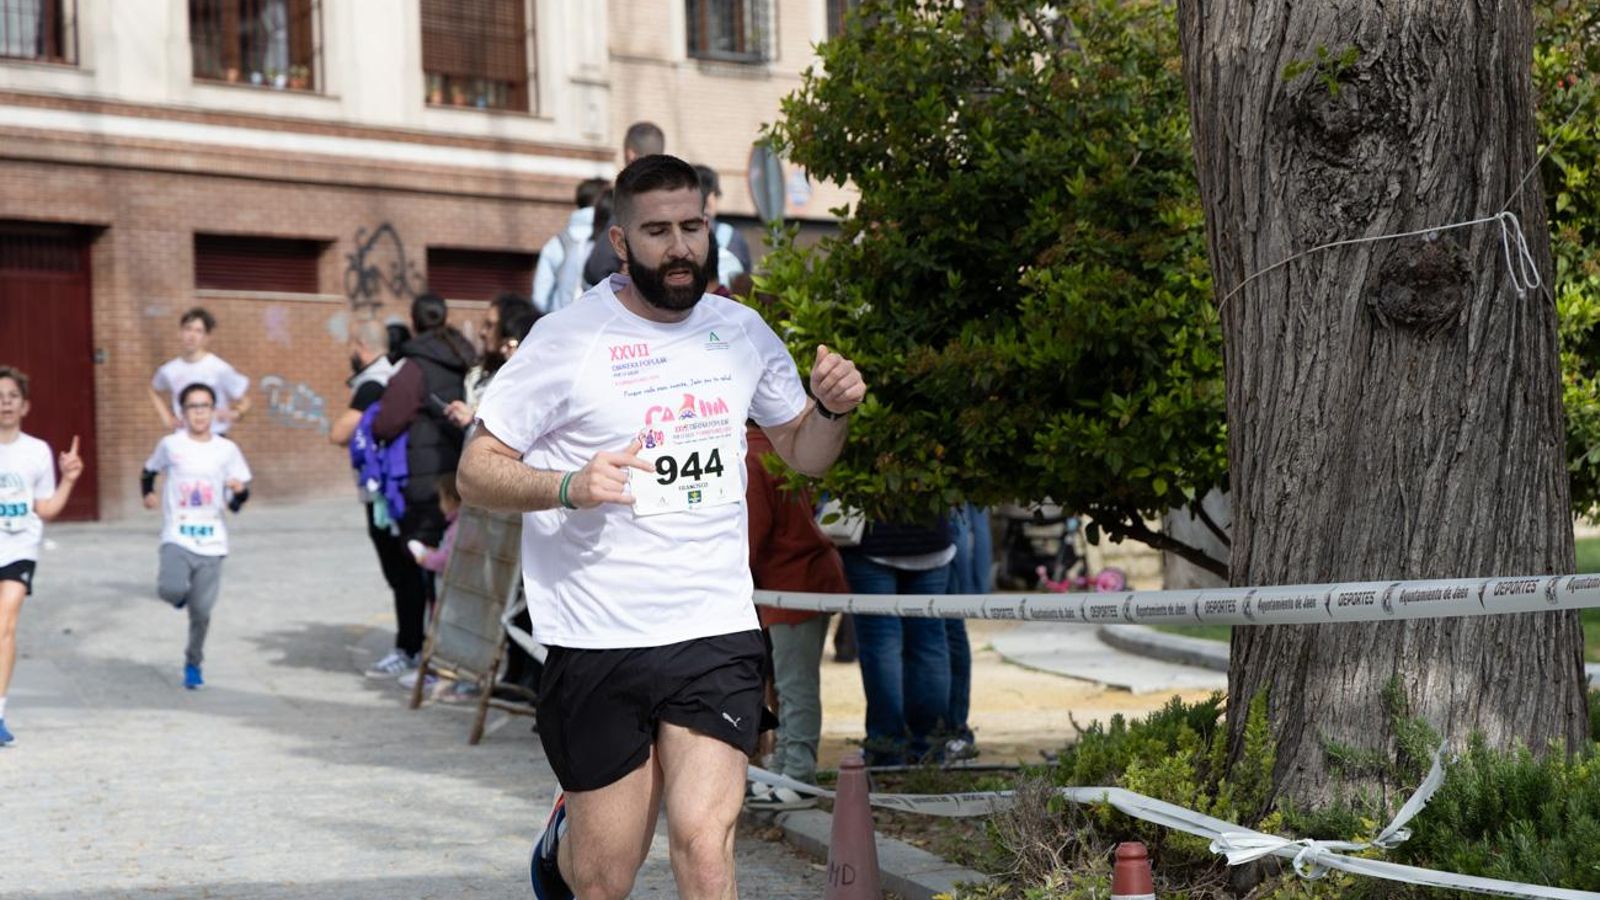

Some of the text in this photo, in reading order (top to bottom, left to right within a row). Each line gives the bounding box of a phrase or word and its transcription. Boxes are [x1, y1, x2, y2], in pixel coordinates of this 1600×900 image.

[608, 343, 650, 361] XXVII
[655, 448, 724, 486] 944
[678, 482, 708, 491] FRANCISCO
[1399, 588, 1442, 606] Ayuntamiento
[1443, 586, 1452, 600] de
[1494, 579, 1540, 596] DEPORTES
[1204, 599, 1237, 614] DEPORTES
[1258, 598, 1293, 614] Ayuntamiento
[1295, 596, 1302, 609] de
[1337, 590, 1376, 607] DEPORTES
[1090, 605, 1118, 618] DEPORTES
